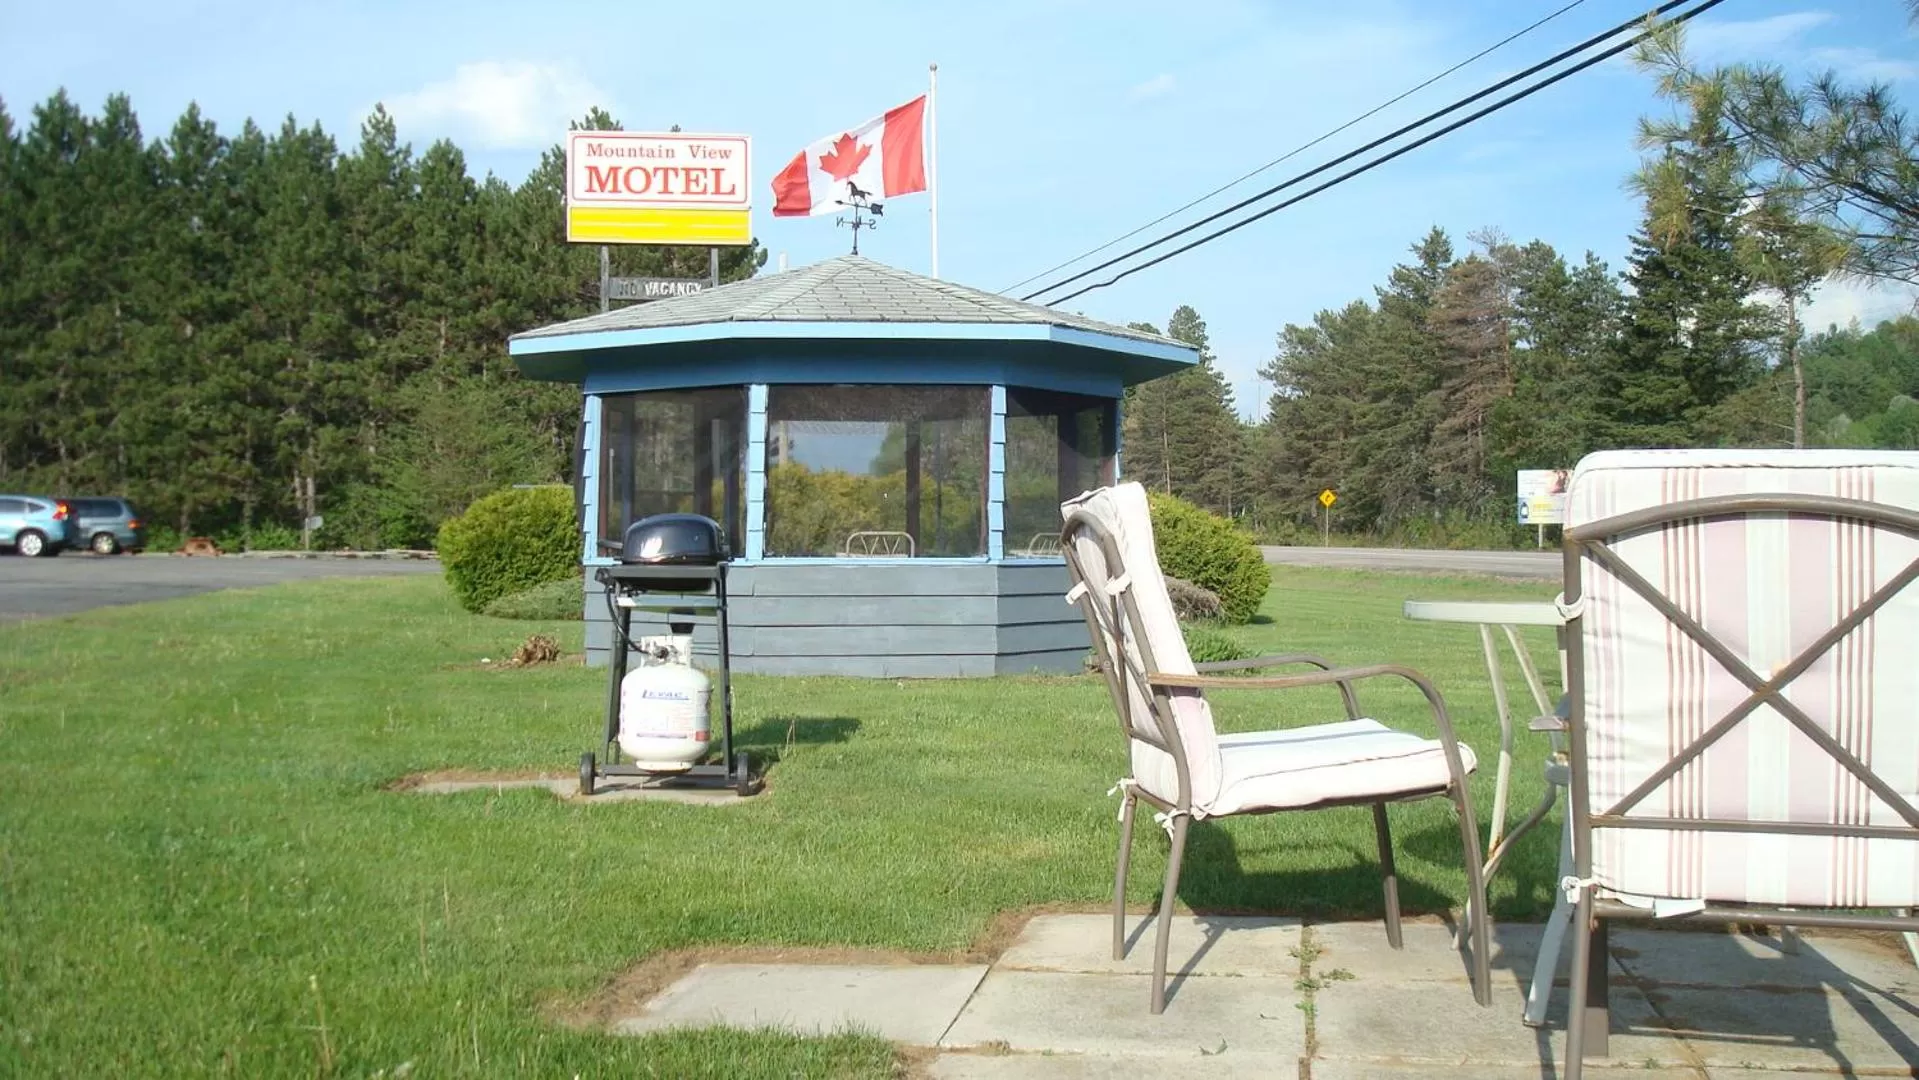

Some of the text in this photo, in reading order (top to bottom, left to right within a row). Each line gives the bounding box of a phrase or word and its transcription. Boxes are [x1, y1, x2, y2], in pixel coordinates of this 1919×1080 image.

[586, 143, 733, 160] Mountain View
[584, 165, 736, 195] MOTEL
[645, 282, 703, 297] VACANCY
